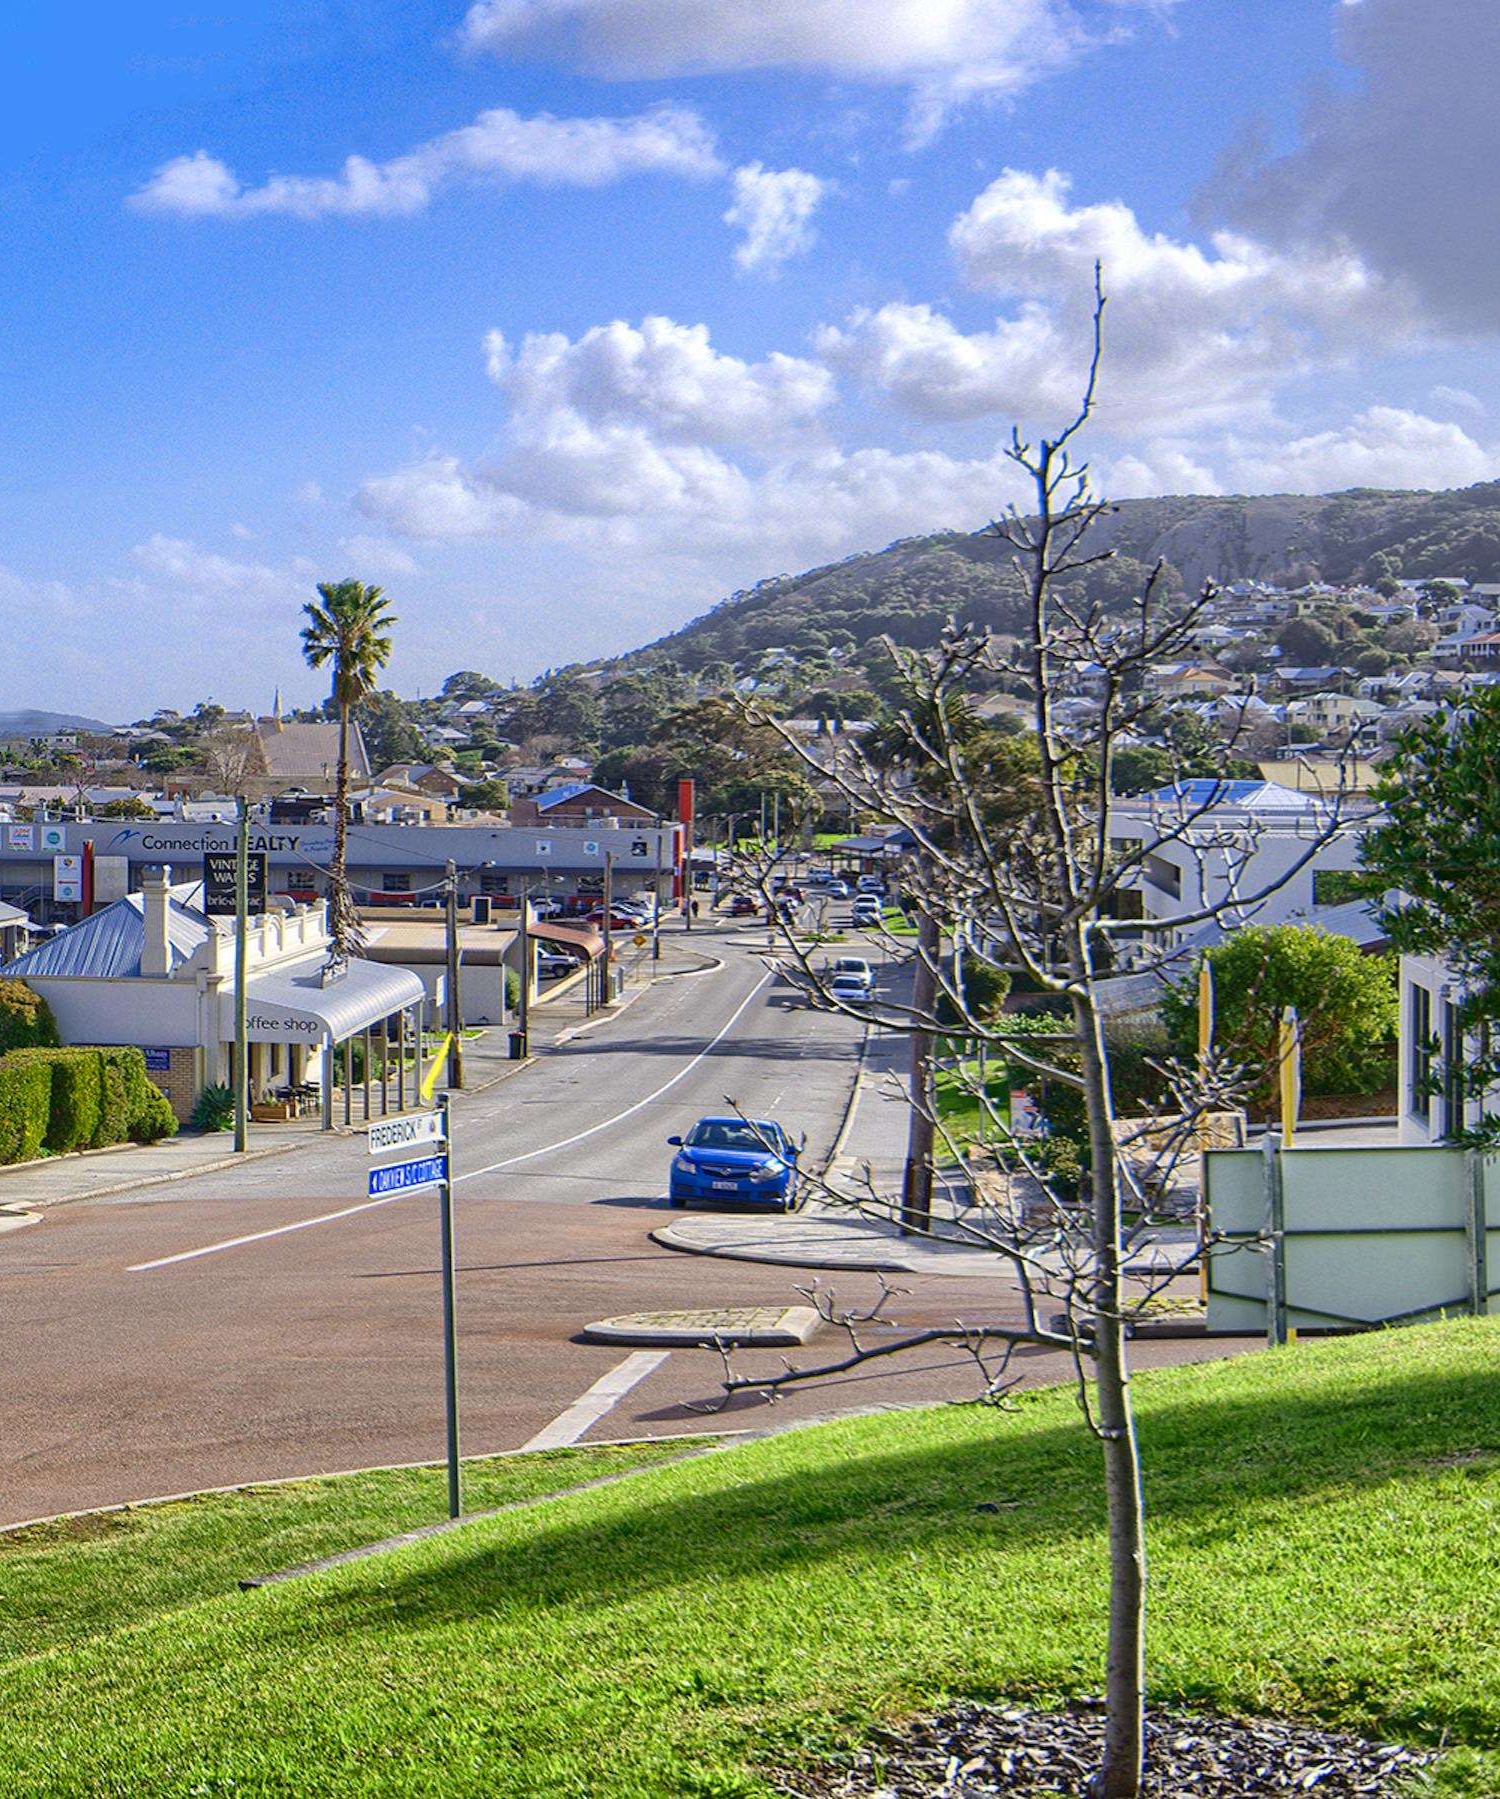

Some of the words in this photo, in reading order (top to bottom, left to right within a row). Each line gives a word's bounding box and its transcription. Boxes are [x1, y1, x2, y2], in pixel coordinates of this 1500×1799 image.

[142, 834, 229, 851] Connection
[233, 836, 300, 851] EALTY
[208, 858, 261, 872] VINTGE
[213, 872, 257, 884] WAS
[244, 1015, 279, 1030] offee
[283, 1016, 318, 1034] shop
[371, 1119, 417, 1149] FREDERICK
